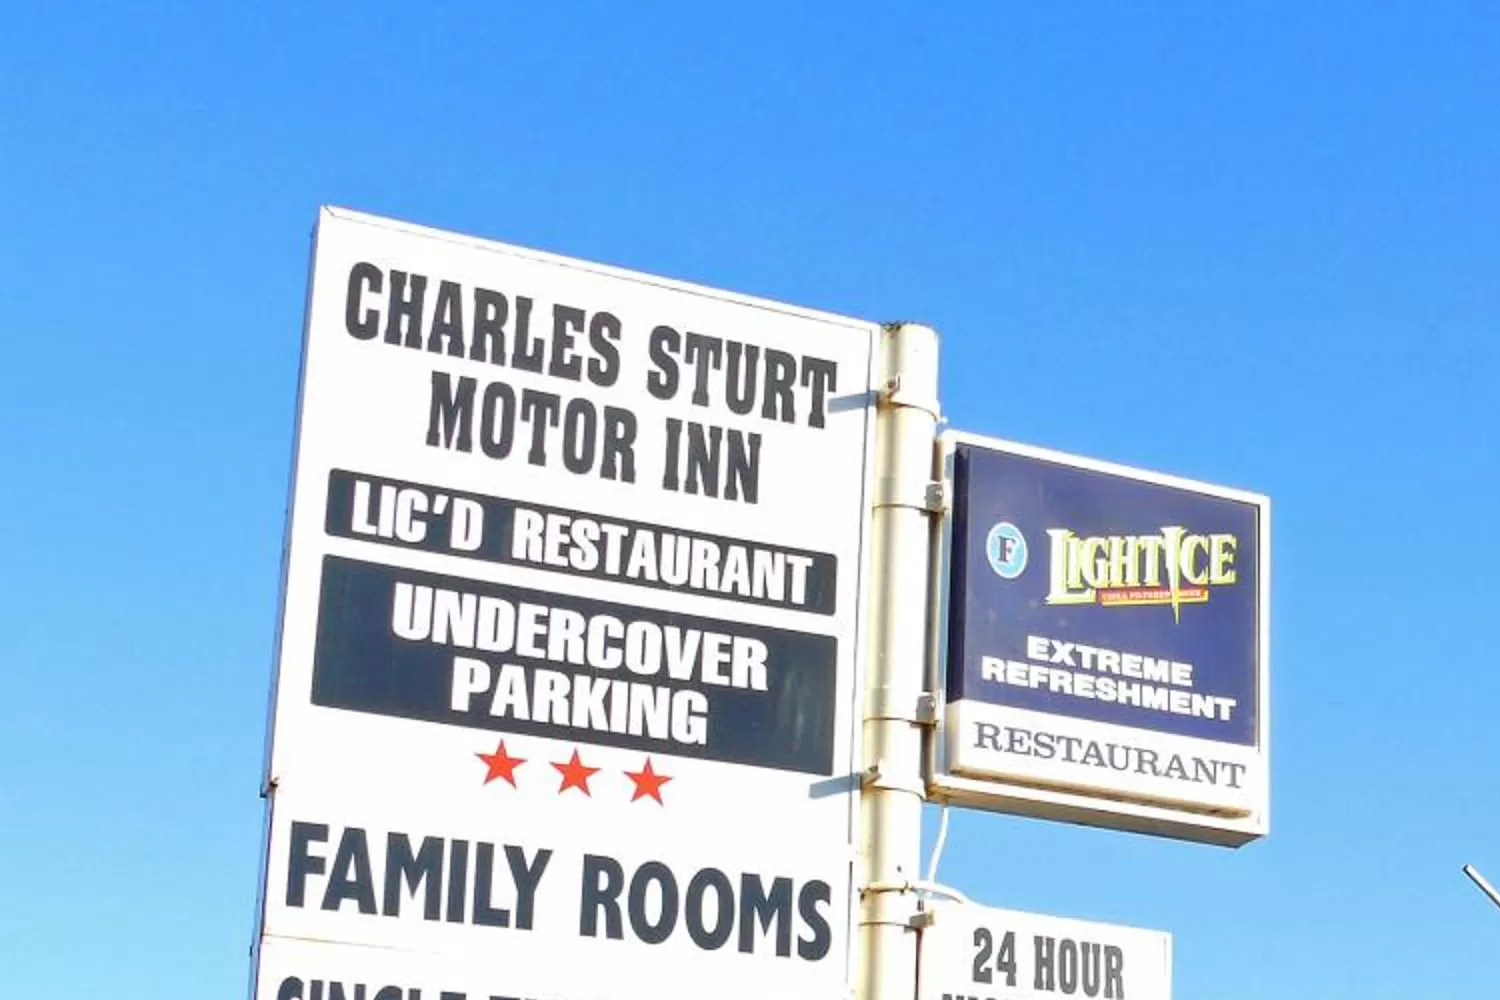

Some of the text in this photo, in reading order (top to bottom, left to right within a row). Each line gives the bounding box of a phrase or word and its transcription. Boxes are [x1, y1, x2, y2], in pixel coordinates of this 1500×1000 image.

[345, 262, 837, 429] CHARLES STURT
[426, 370, 762, 504] MOTOR INN
[350, 481, 813, 605] LIC'D RESTAURANT
[391, 582, 769, 691] UNDERCOVER
[1026, 635, 1193, 686] EXTREME
[450, 658, 709, 745] PARKING
[981, 656, 1236, 721] REFRESHMENT
[973, 721, 1246, 789] RESTAURANT
[285, 820, 832, 962] FAMILY ROOMS
[972, 927, 1124, 1000] 24 HOUR
